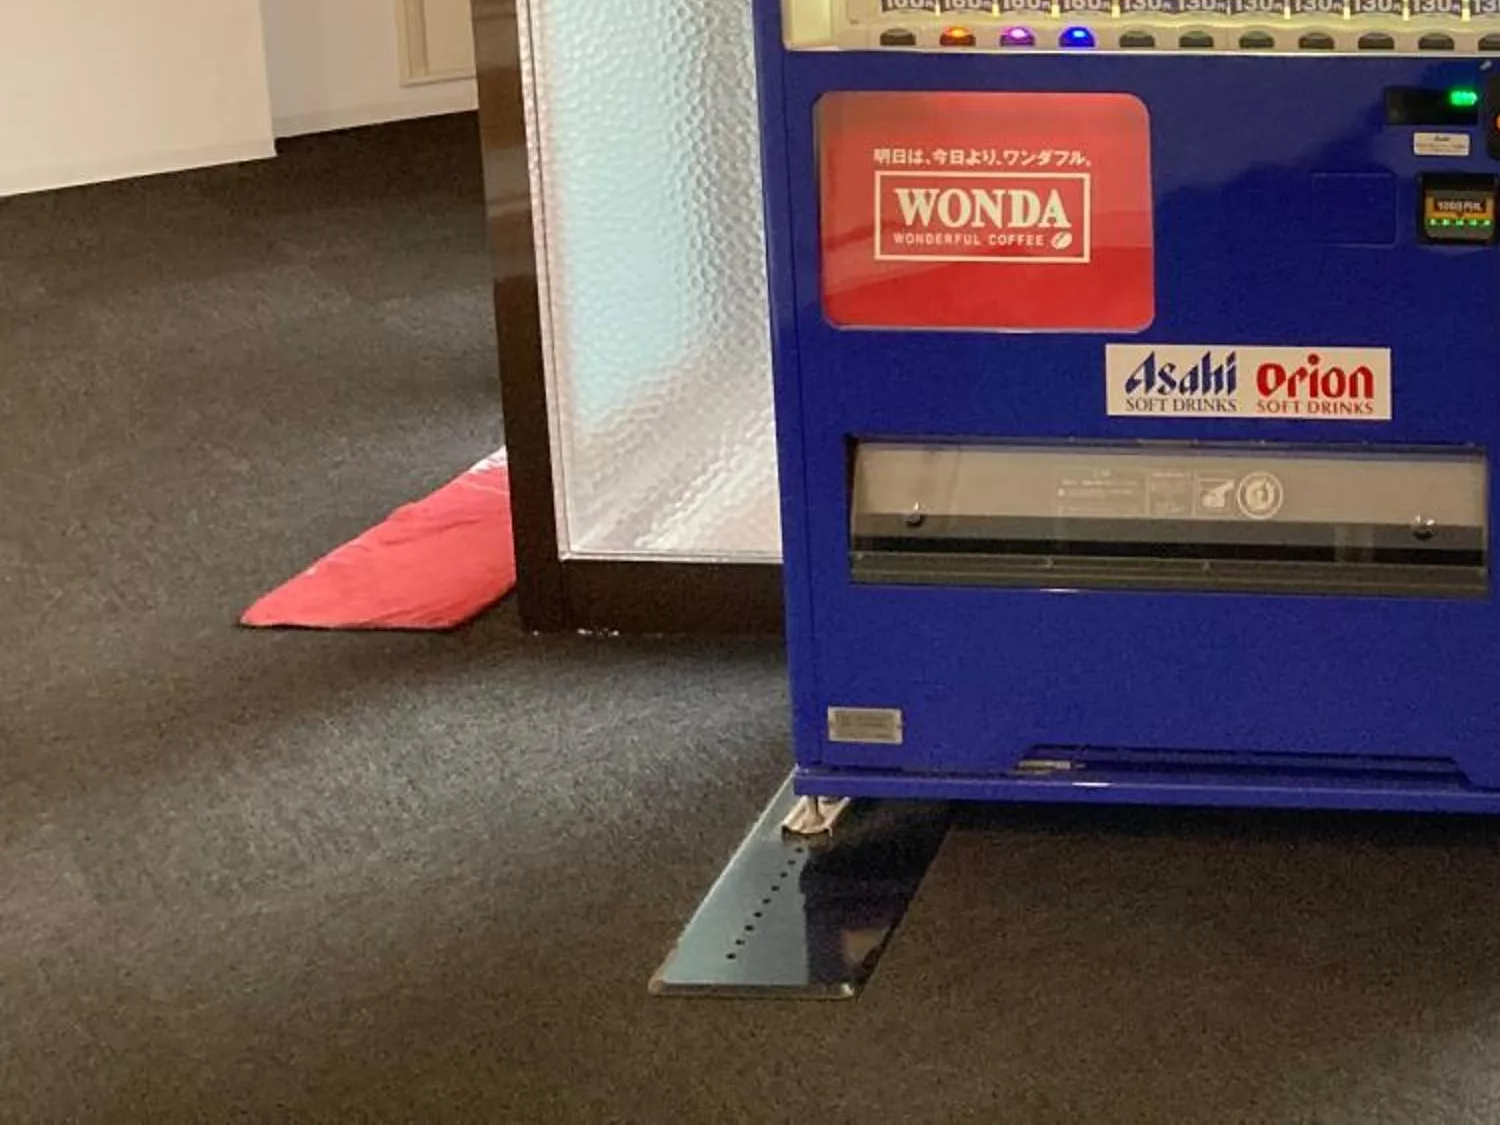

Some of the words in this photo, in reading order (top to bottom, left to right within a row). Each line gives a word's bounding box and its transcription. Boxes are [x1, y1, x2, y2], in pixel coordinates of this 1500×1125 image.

[873, 147, 1092, 166] 明日は、今日より、ワンダフル。
[893, 188, 1072, 229] WONDA
[893, 232, 982, 246] WONDERFUL
[988, 234, 1046, 247] COFFEE
[1125, 350, 1237, 396] Asahi
[1125, 398, 1168, 412] SOFT
[1172, 398, 1238, 413] DRINKS
[1256, 400, 1301, 414] SOFT
[1307, 401, 1375, 416] DRINKS
